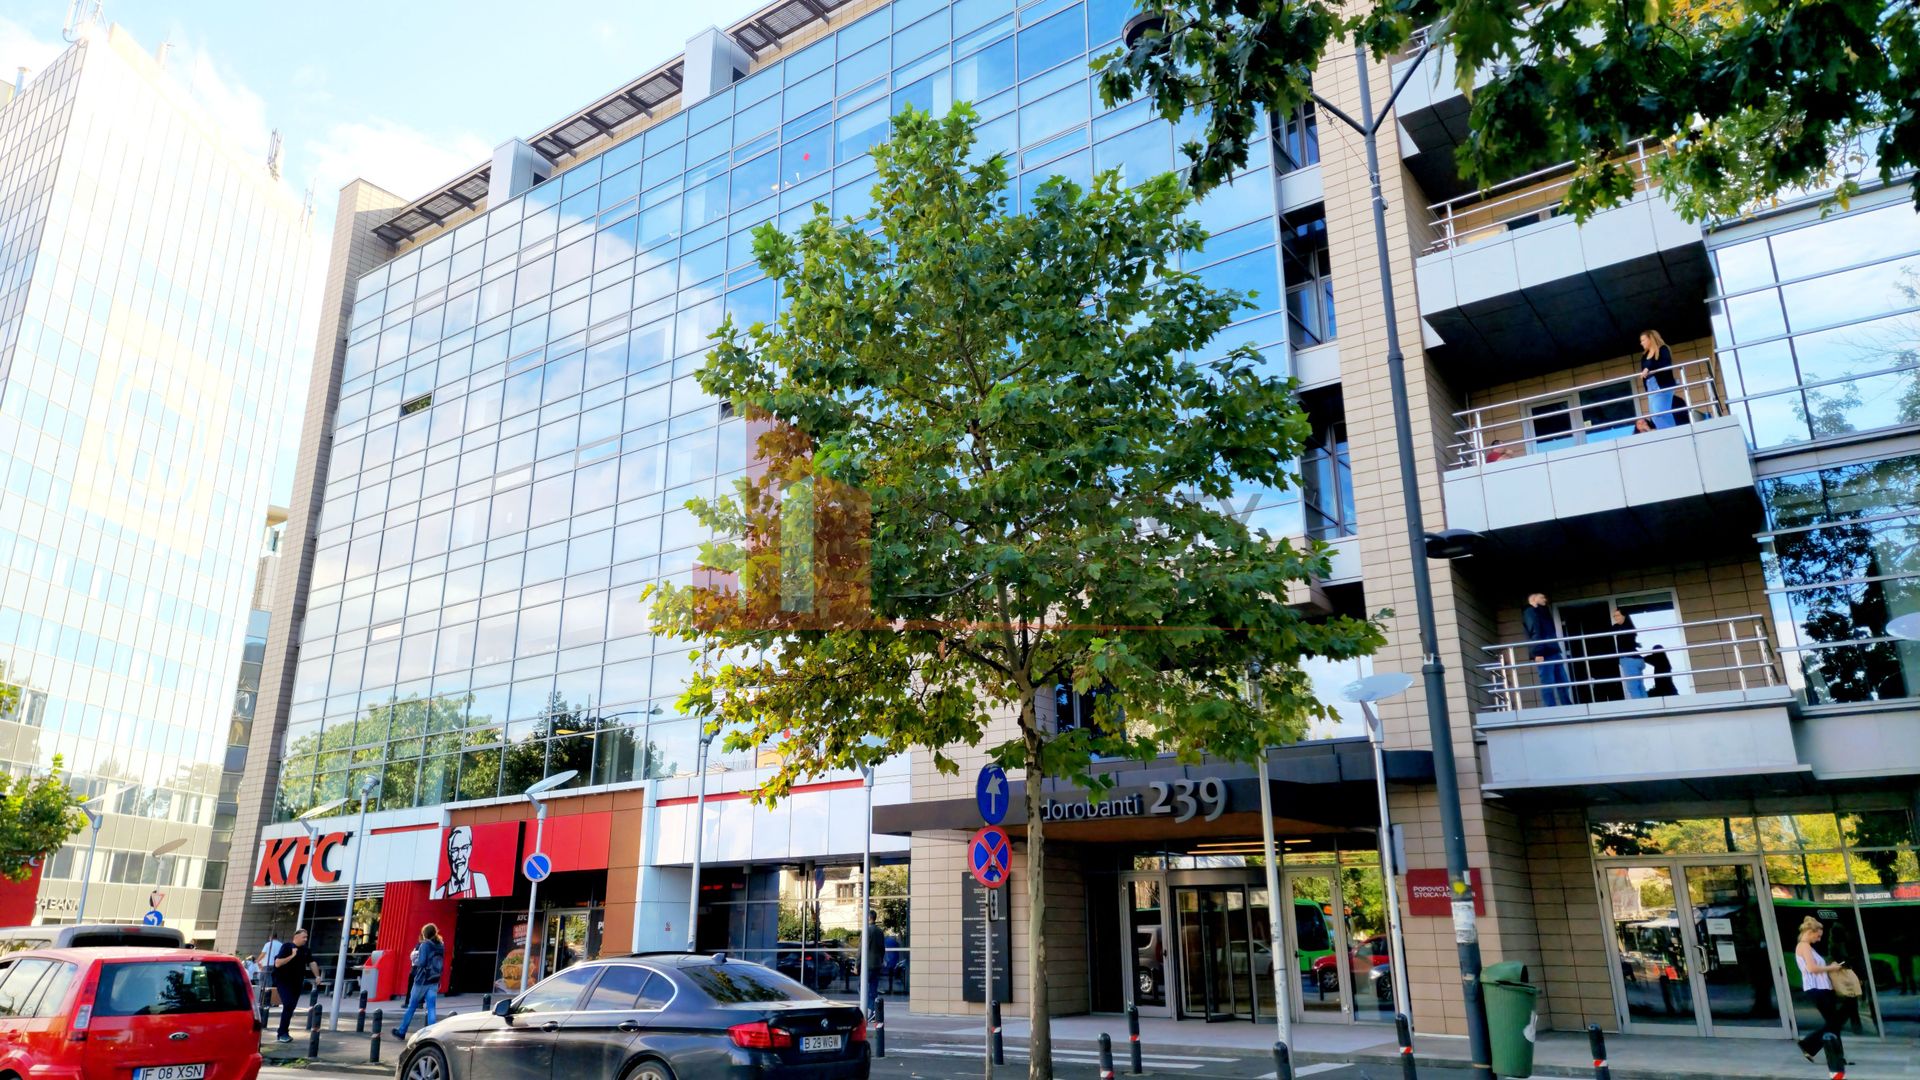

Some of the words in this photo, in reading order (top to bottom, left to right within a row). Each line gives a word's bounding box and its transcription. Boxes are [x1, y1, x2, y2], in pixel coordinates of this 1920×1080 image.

[1149, 777, 1228, 824] 239
[252, 831, 354, 887] KFC
[804, 1038, 810, 1049] B
[141, 1068, 155, 1080] IF
[158, 1067, 174, 1080] 08
[177, 1064, 204, 1079] XSN
